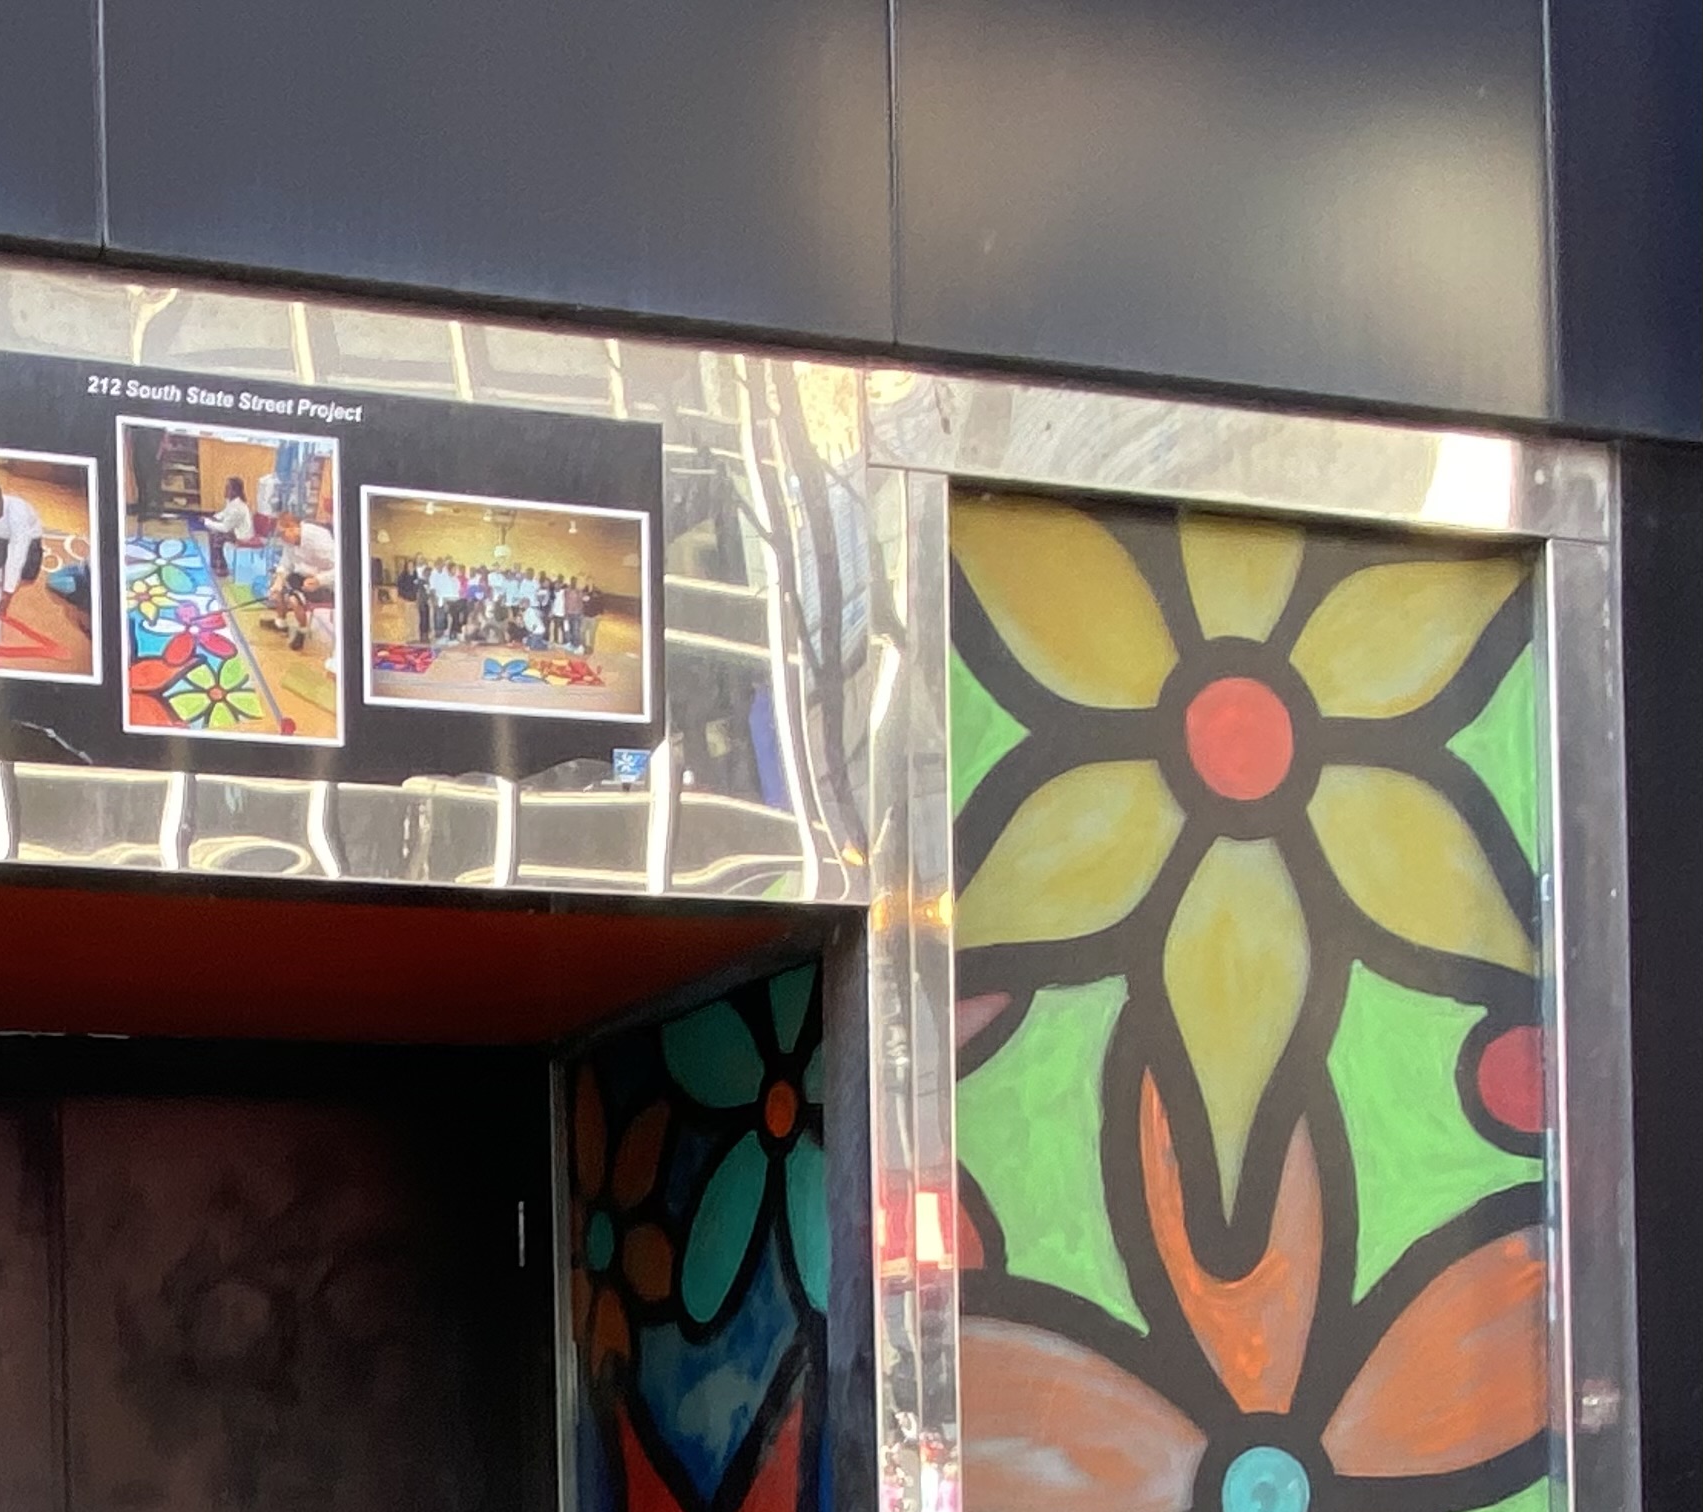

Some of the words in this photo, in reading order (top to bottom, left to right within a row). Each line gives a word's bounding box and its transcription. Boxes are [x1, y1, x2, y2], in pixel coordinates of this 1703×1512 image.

[87, 376, 121, 396] 212
[126, 380, 181, 403] South
[186, 386, 234, 408] State
[238, 391, 294, 415] Street
[297, 399, 362, 423] Project
